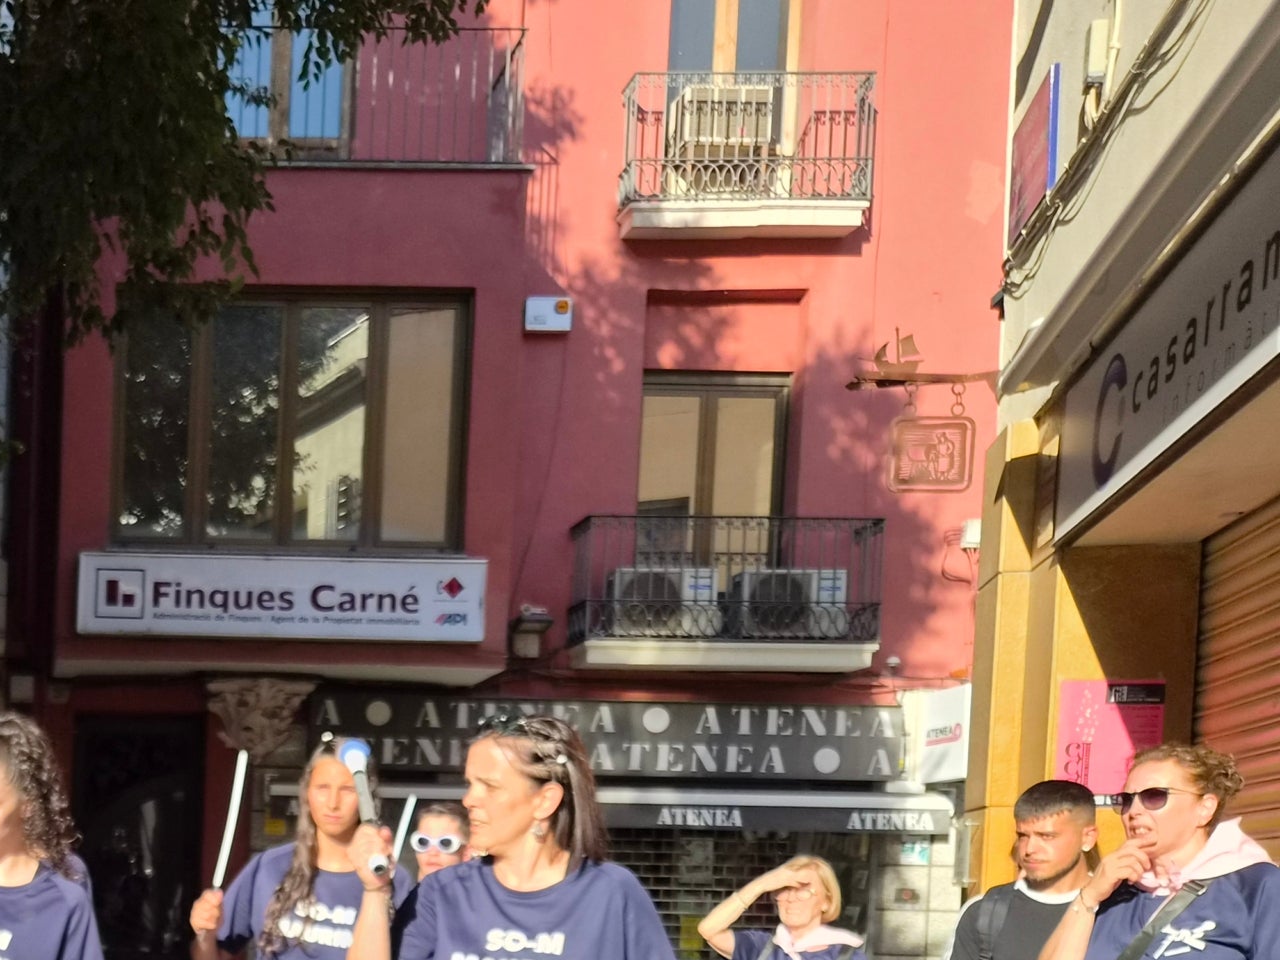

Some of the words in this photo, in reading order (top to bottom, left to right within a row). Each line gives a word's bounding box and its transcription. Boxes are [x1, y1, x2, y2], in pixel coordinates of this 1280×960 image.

[152, 581, 294, 613] Finques
[309, 585, 420, 614] Carné
[695, 705, 897, 739] ATENEA
[926, 725, 954, 739] ATENEA
[590, 742, 787, 775] ATENEA
[656, 807, 744, 828] ATENEA
[846, 811, 935, 832] ATENEA
[484, 927, 567, 956] SO-M
